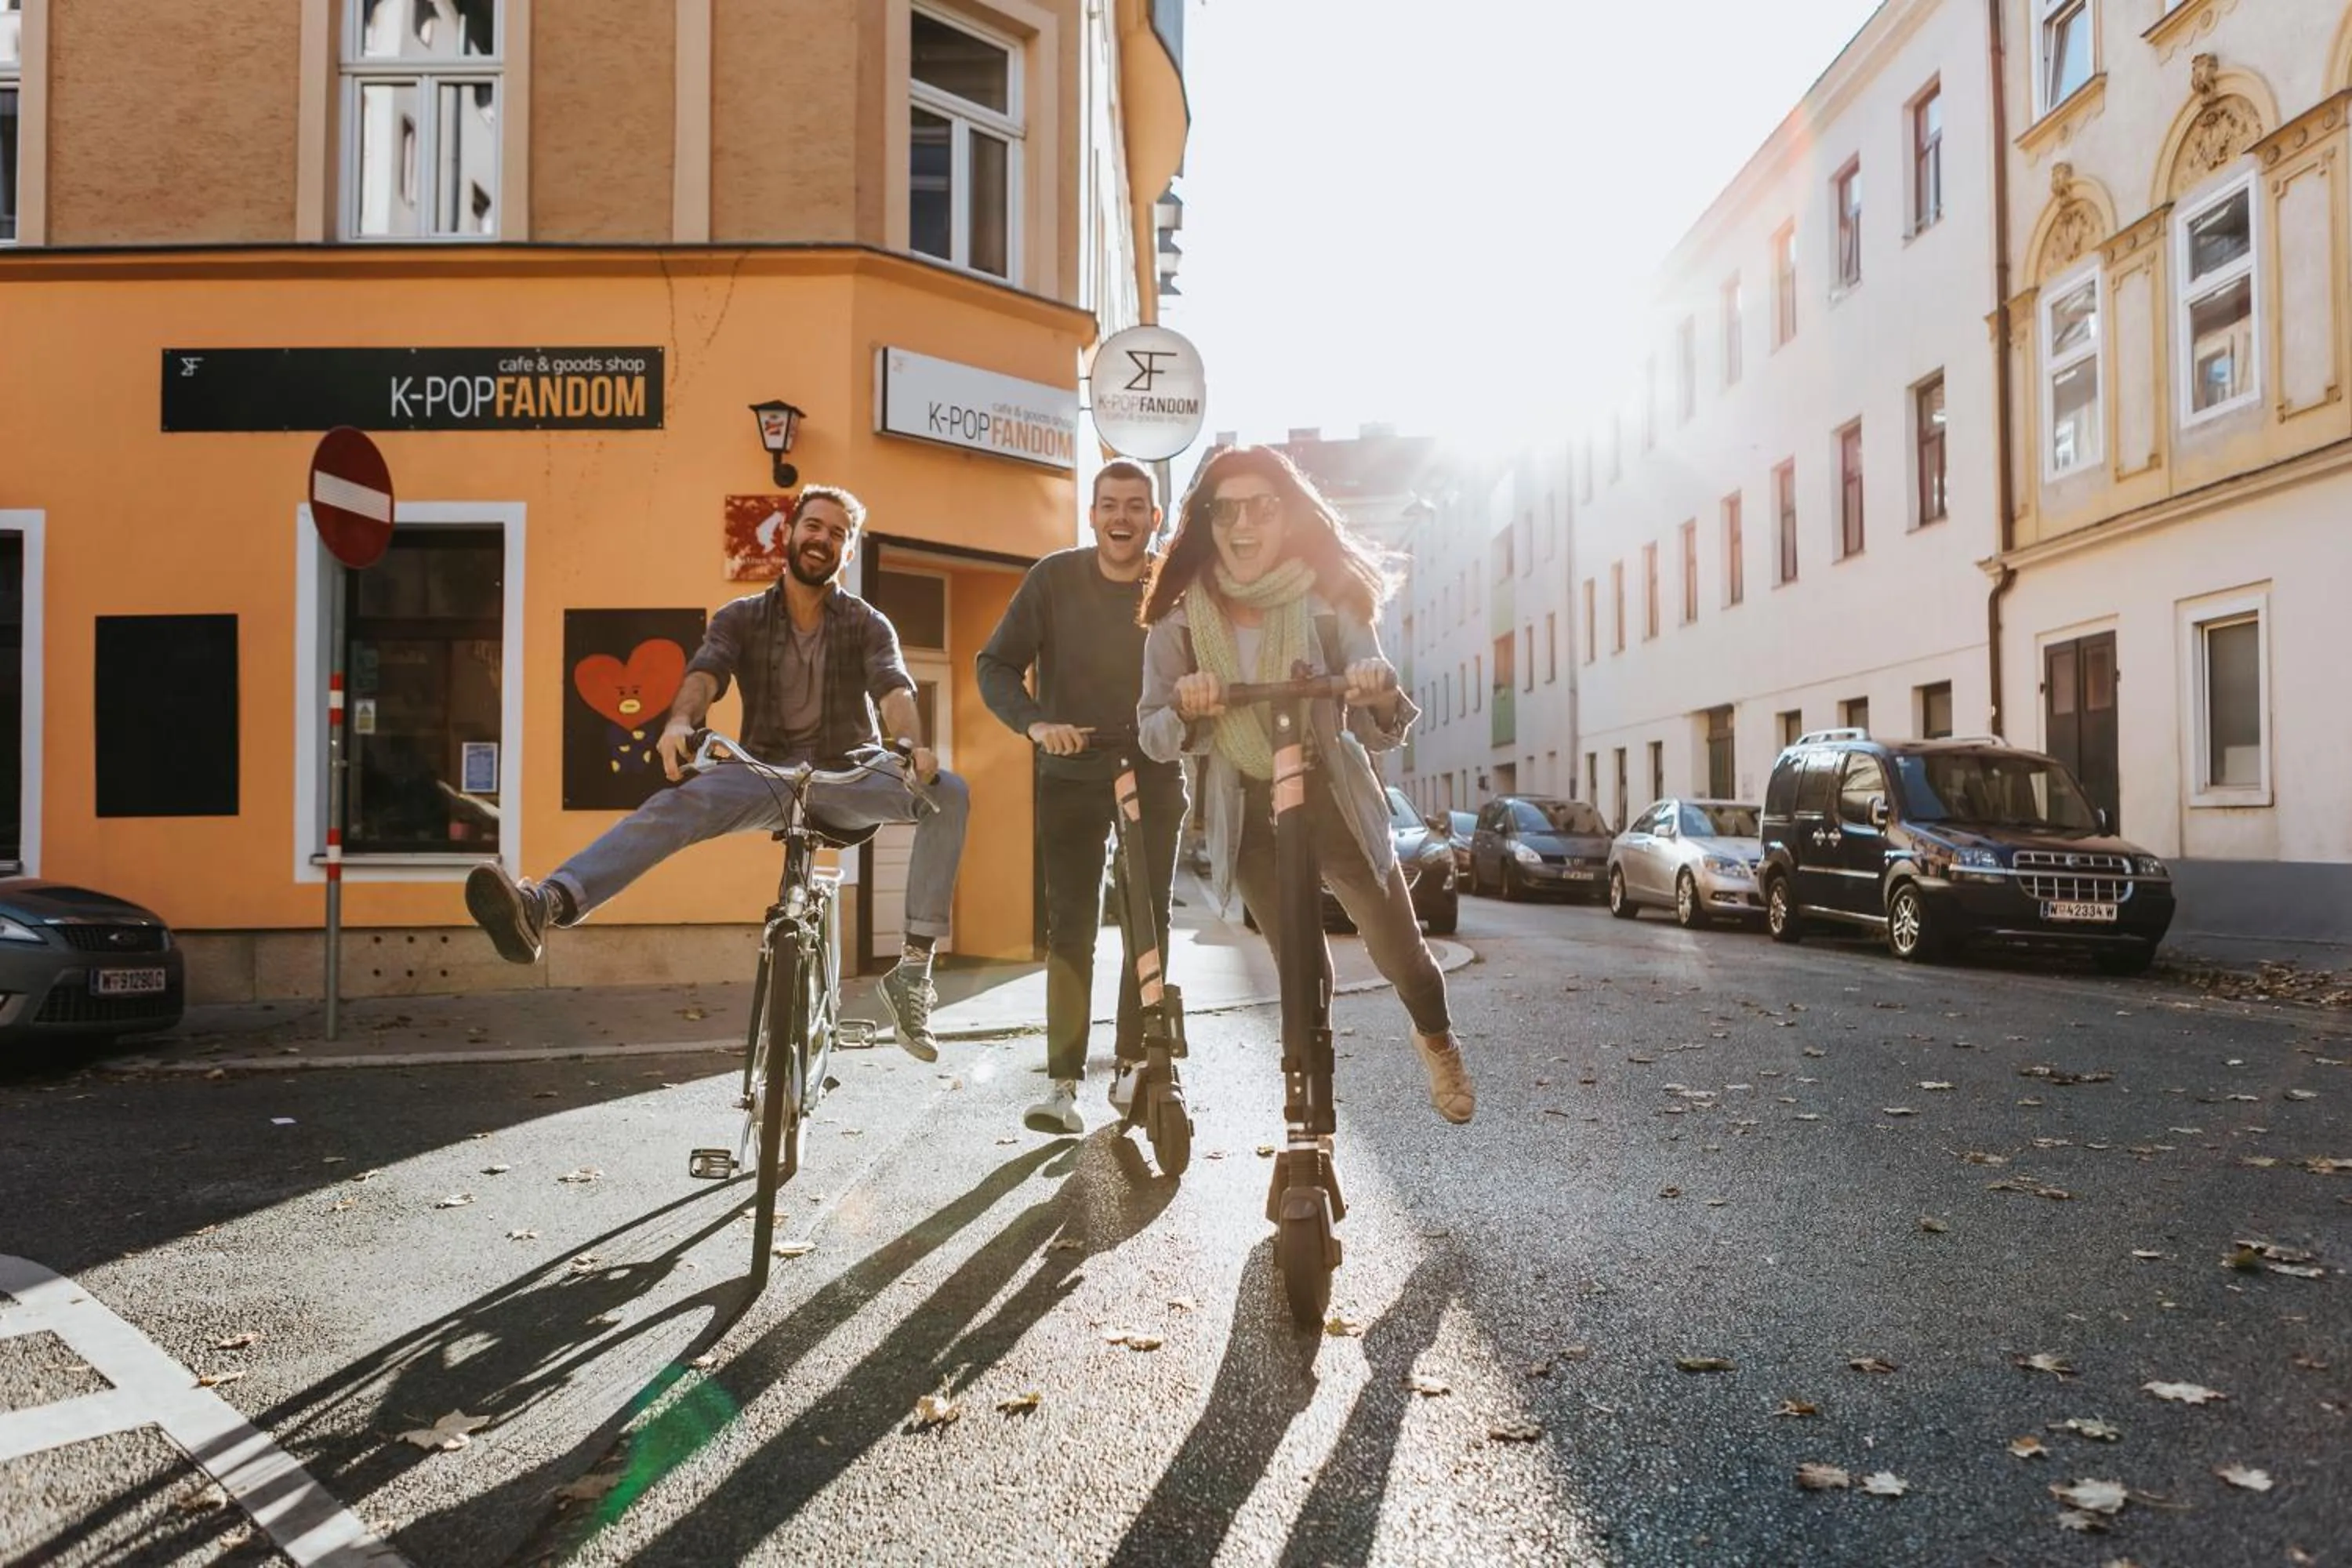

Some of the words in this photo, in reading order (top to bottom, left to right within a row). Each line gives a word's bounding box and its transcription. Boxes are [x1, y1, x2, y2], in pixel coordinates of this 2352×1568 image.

[498, 356, 534, 372] cafe
[536, 357, 550, 372] &
[553, 356, 603, 376] goods
[605, 356, 646, 374] shop
